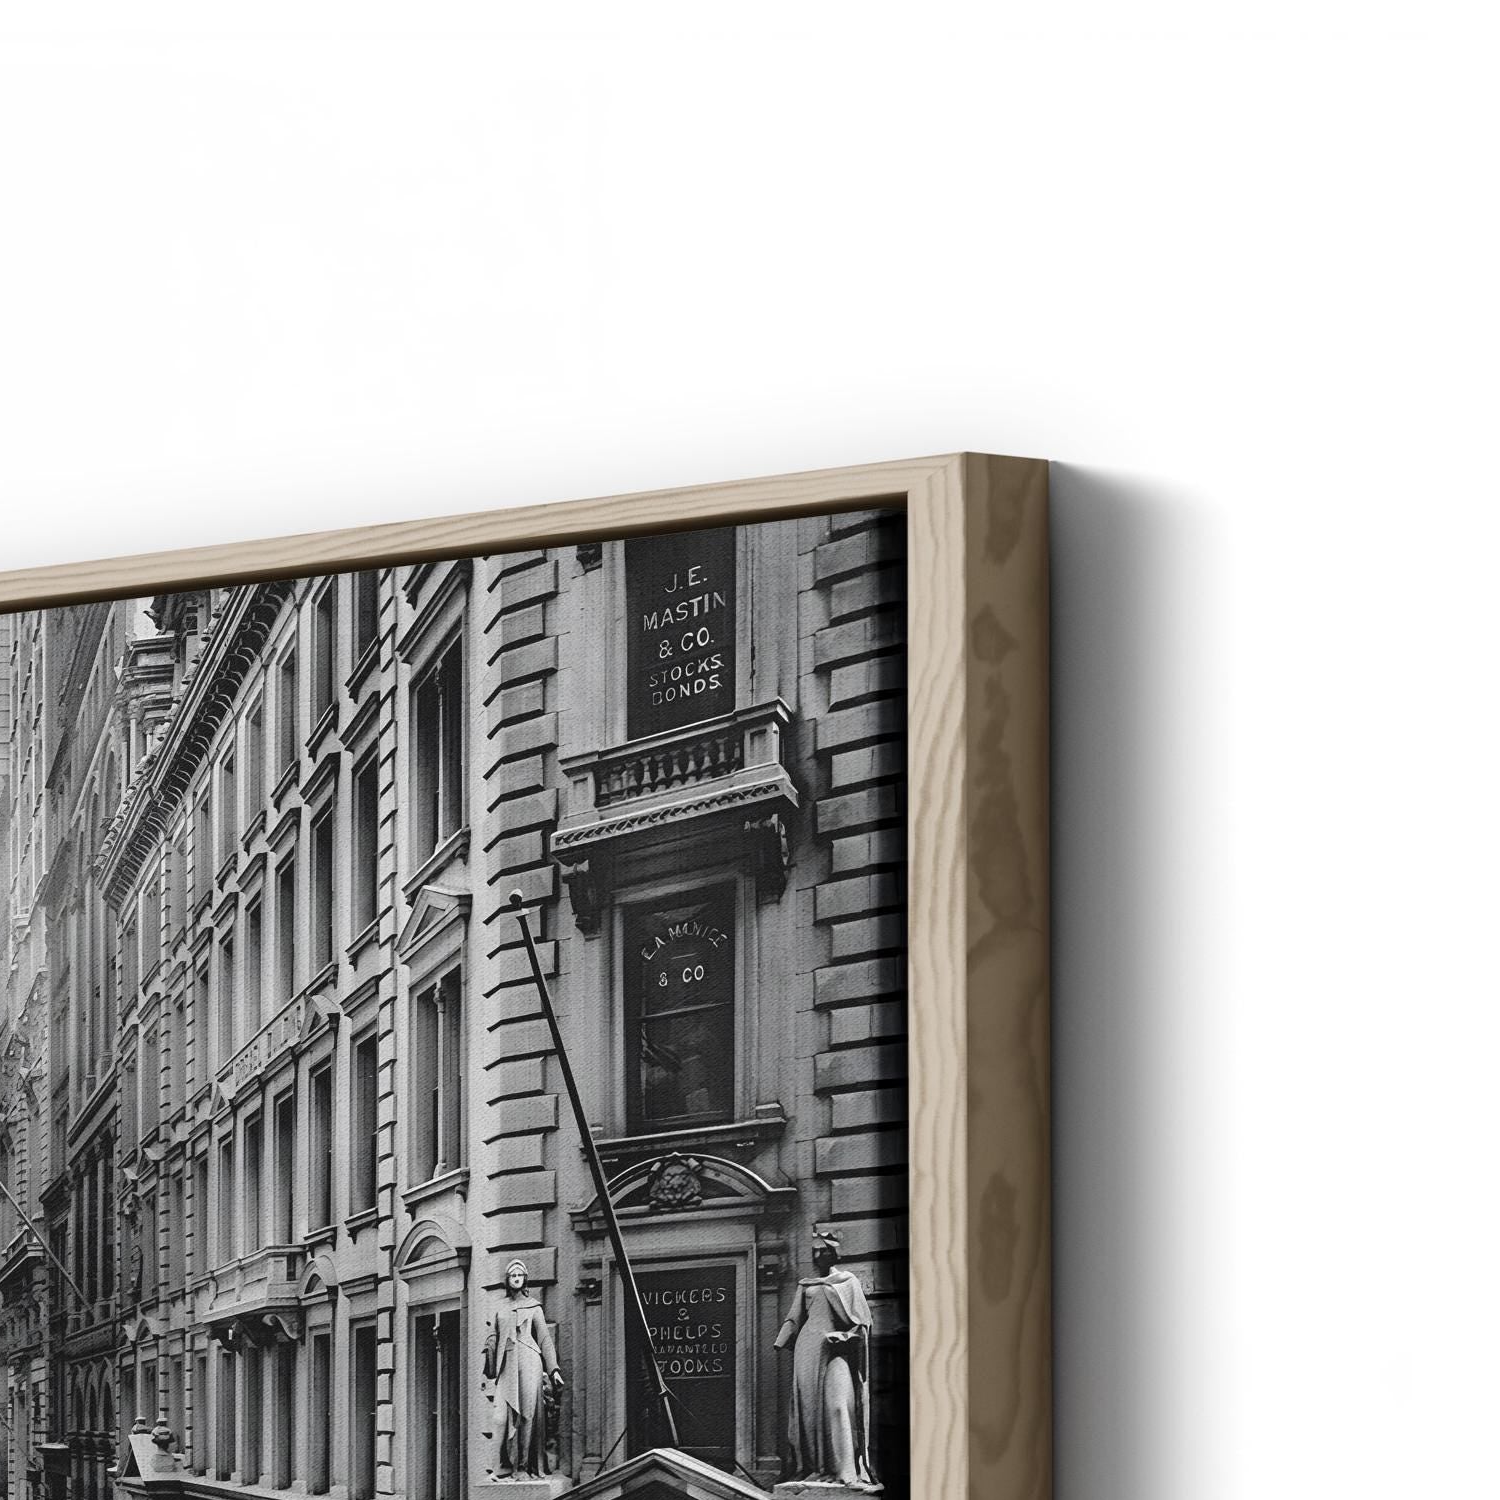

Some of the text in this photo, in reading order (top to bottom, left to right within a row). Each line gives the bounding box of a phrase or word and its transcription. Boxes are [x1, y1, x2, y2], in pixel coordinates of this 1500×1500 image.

[664, 565, 708, 593] J.E.
[643, 591, 727, 631] MASTIN
[659, 627, 715, 659] & CO.
[649, 653, 725, 688] STOCKS
[651, 673, 723, 706] BONDS
[682, 964, 705, 983] CO
